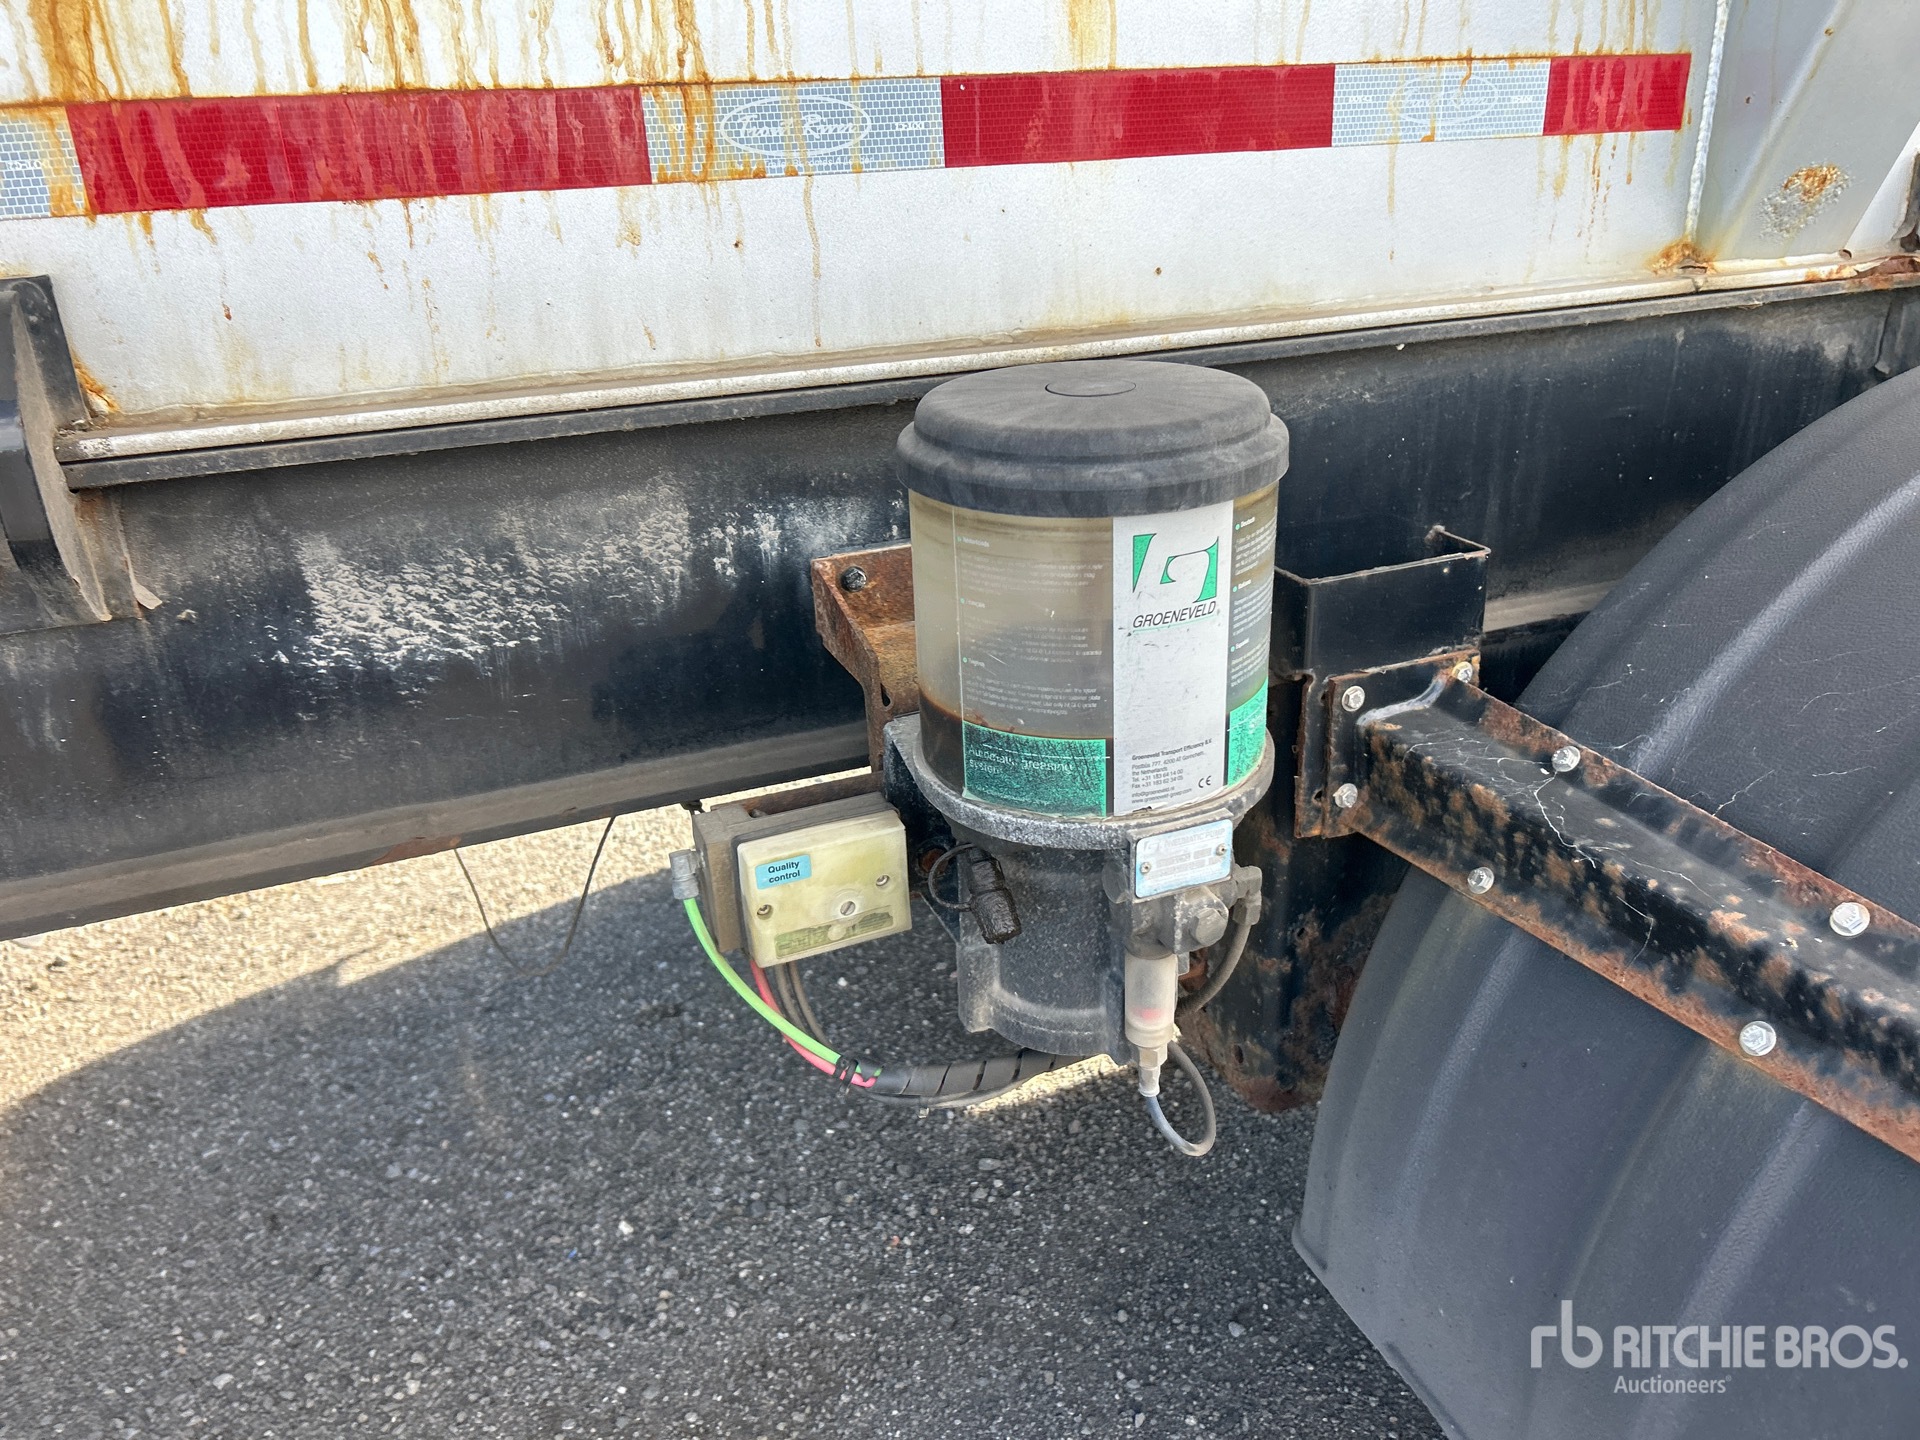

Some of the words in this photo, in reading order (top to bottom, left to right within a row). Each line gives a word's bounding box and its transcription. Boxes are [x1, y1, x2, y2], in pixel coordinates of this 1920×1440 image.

[1132, 600, 1217, 628] GROENEVELD
[1131, 752, 1161, 761] Groeneveld
[1161, 746, 1183, 756] Transport
[1183, 741, 1204, 752] Efficiency
[767, 861, 800, 874] Quality
[768, 869, 801, 883] control
